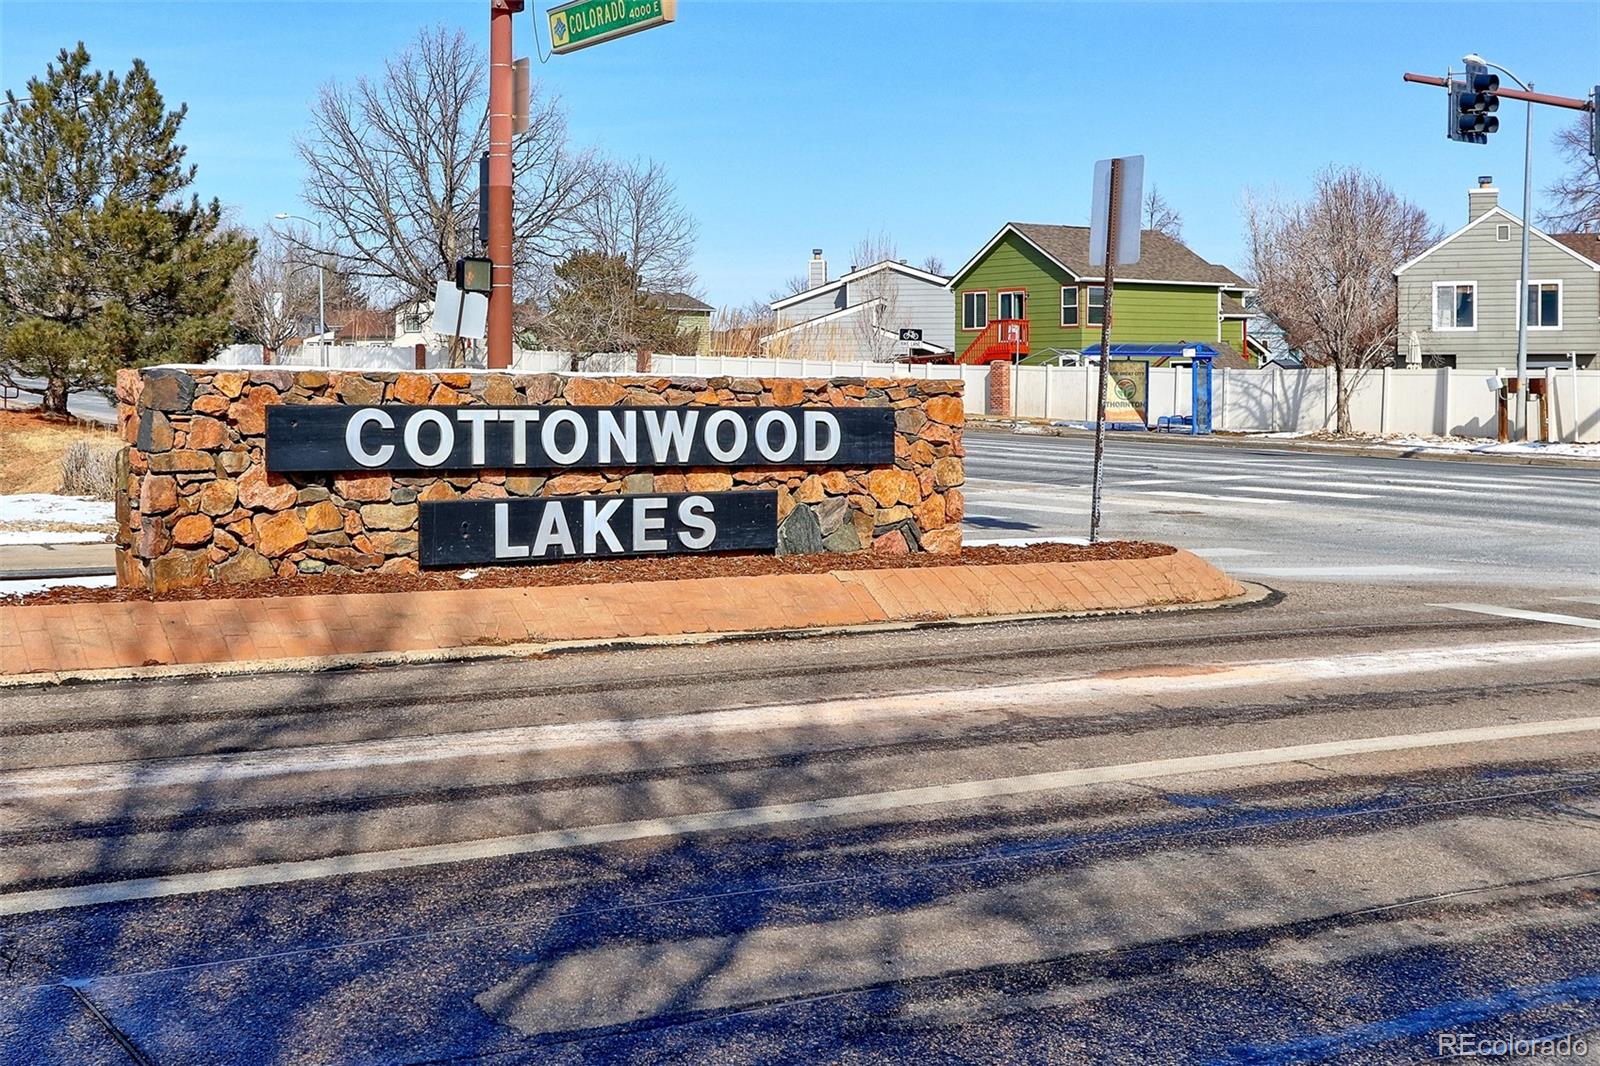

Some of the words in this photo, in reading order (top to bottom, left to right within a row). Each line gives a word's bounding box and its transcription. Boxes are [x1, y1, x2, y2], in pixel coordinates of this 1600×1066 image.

[569, 0, 625, 34] COLORADO
[629, 4, 651, 18] 4000
[653, 2, 659, 12] E
[345, 408, 841, 468] COTTONWOOD
[494, 495, 717, 558] LAKES
